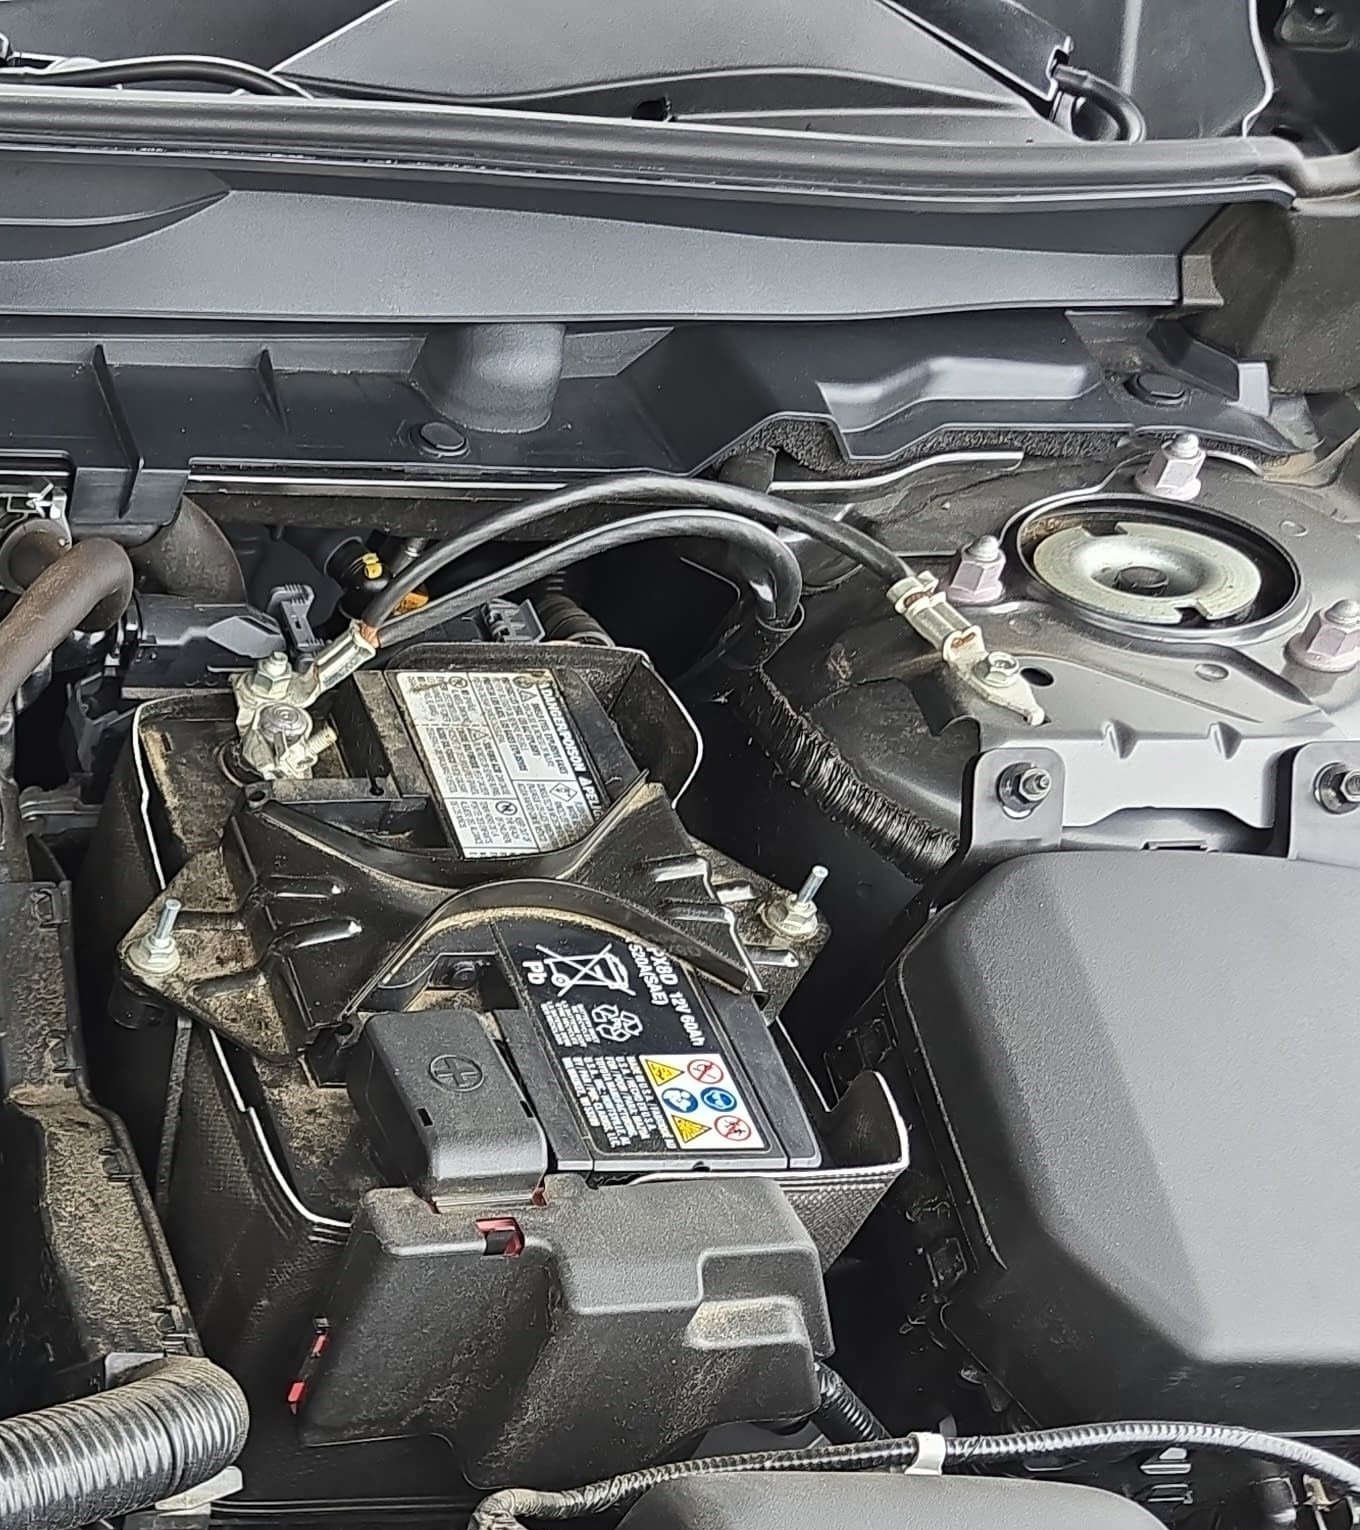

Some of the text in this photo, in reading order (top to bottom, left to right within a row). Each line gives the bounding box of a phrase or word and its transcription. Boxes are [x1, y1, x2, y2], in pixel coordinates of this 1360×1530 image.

[583, 785, 605, 821] PELIG
[522, 960, 547, 985] Pb
[669, 992, 691, 1016] 12V
